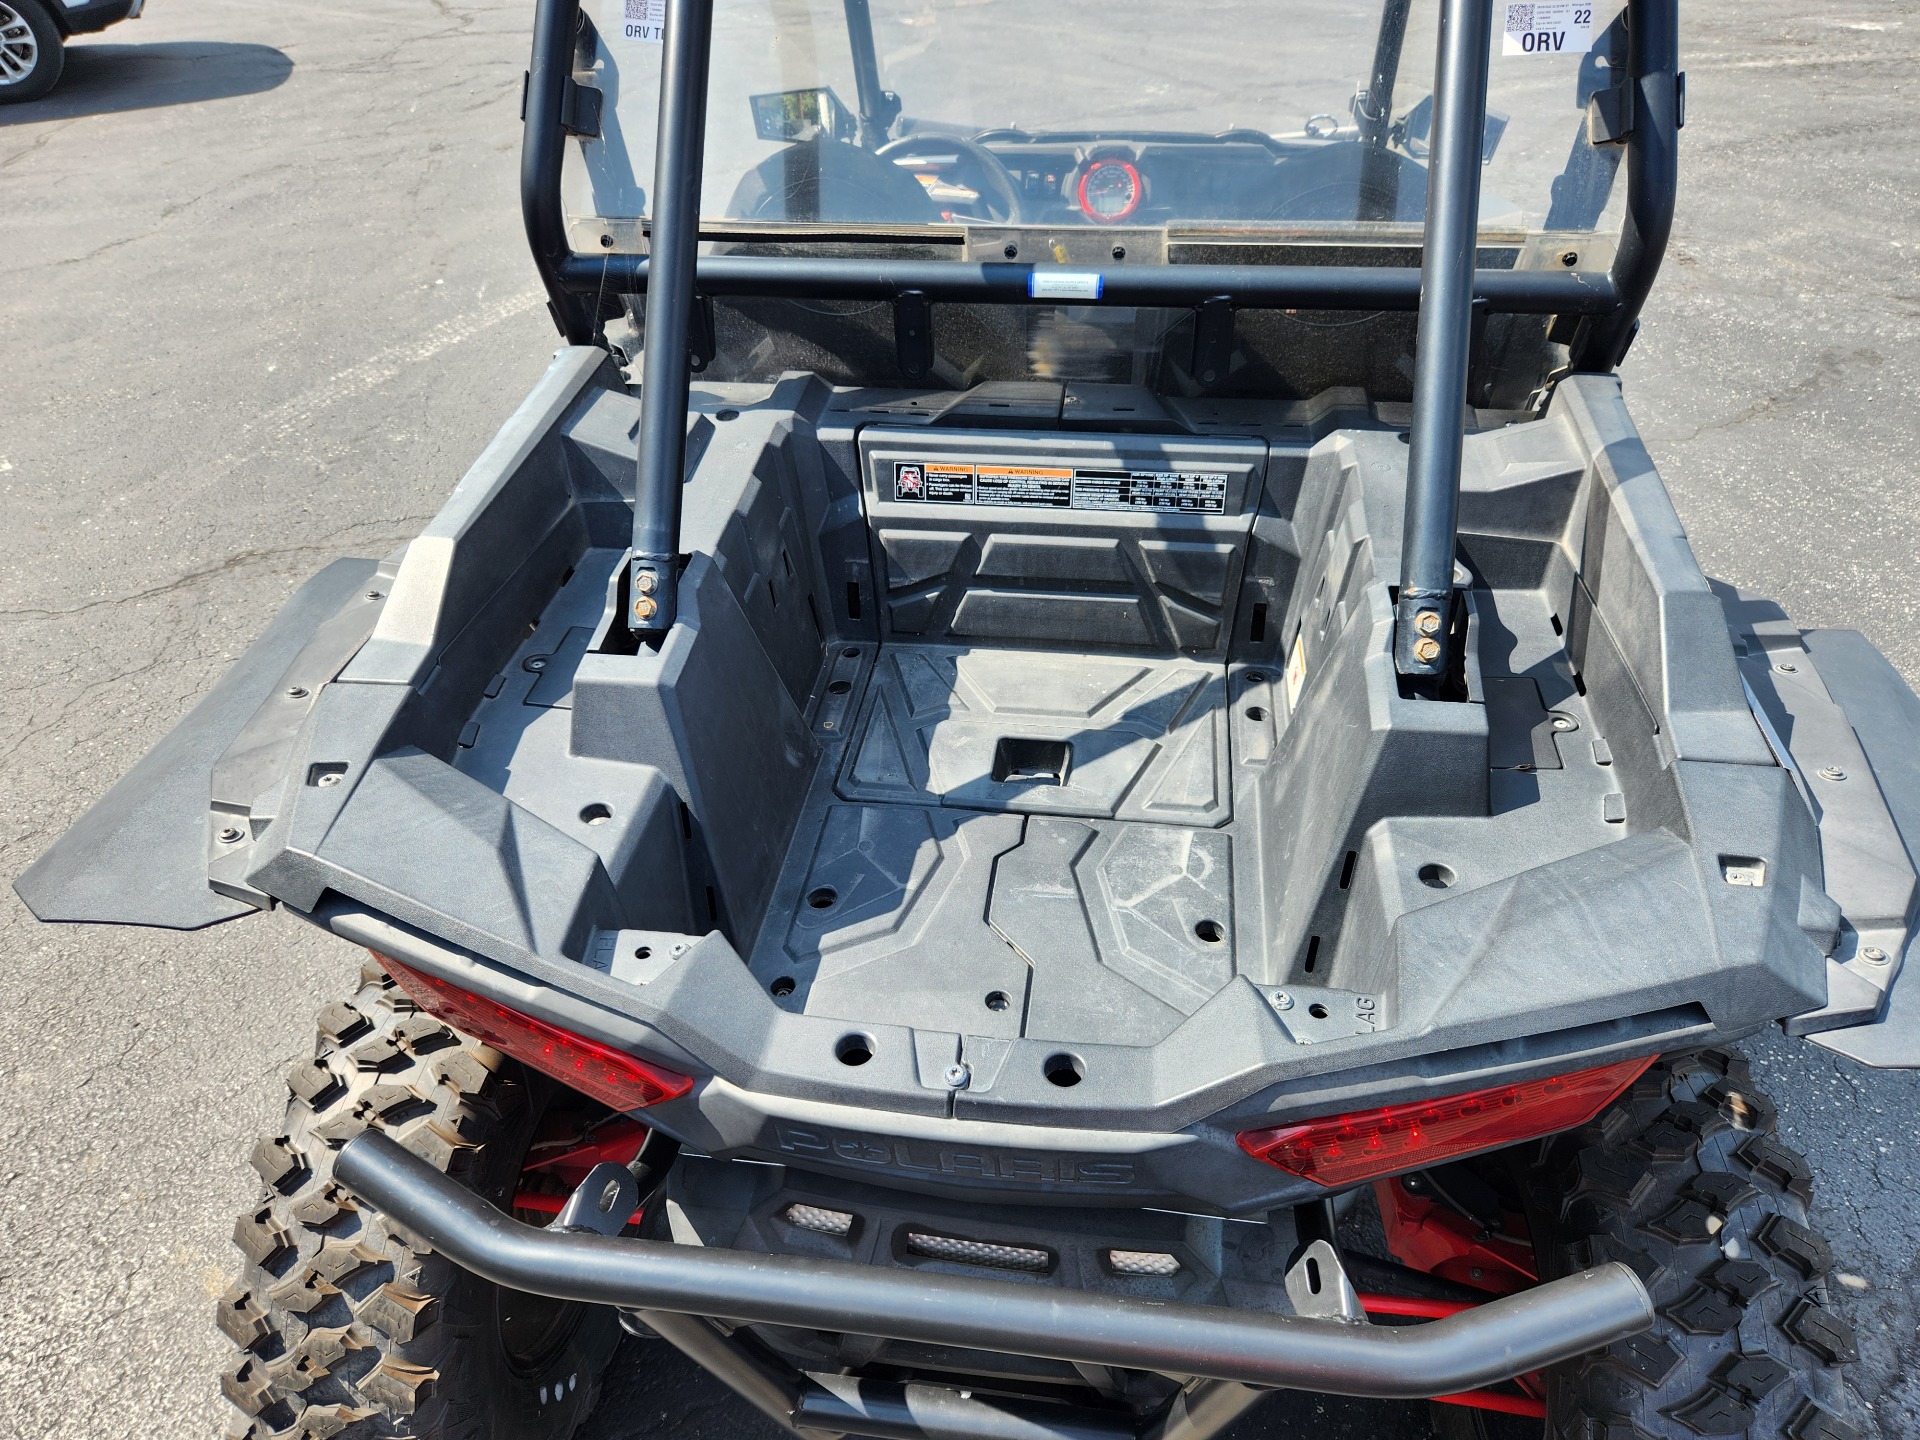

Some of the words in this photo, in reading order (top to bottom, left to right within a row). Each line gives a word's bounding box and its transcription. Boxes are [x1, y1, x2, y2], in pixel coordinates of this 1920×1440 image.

[1574, 9, 1591, 24] 22
[625, 24, 650, 39] ORV
[1522, 31, 1566, 52] ORV
[592, 937, 615, 970] FLA
[775, 1124, 1135, 1185] POLARIS
